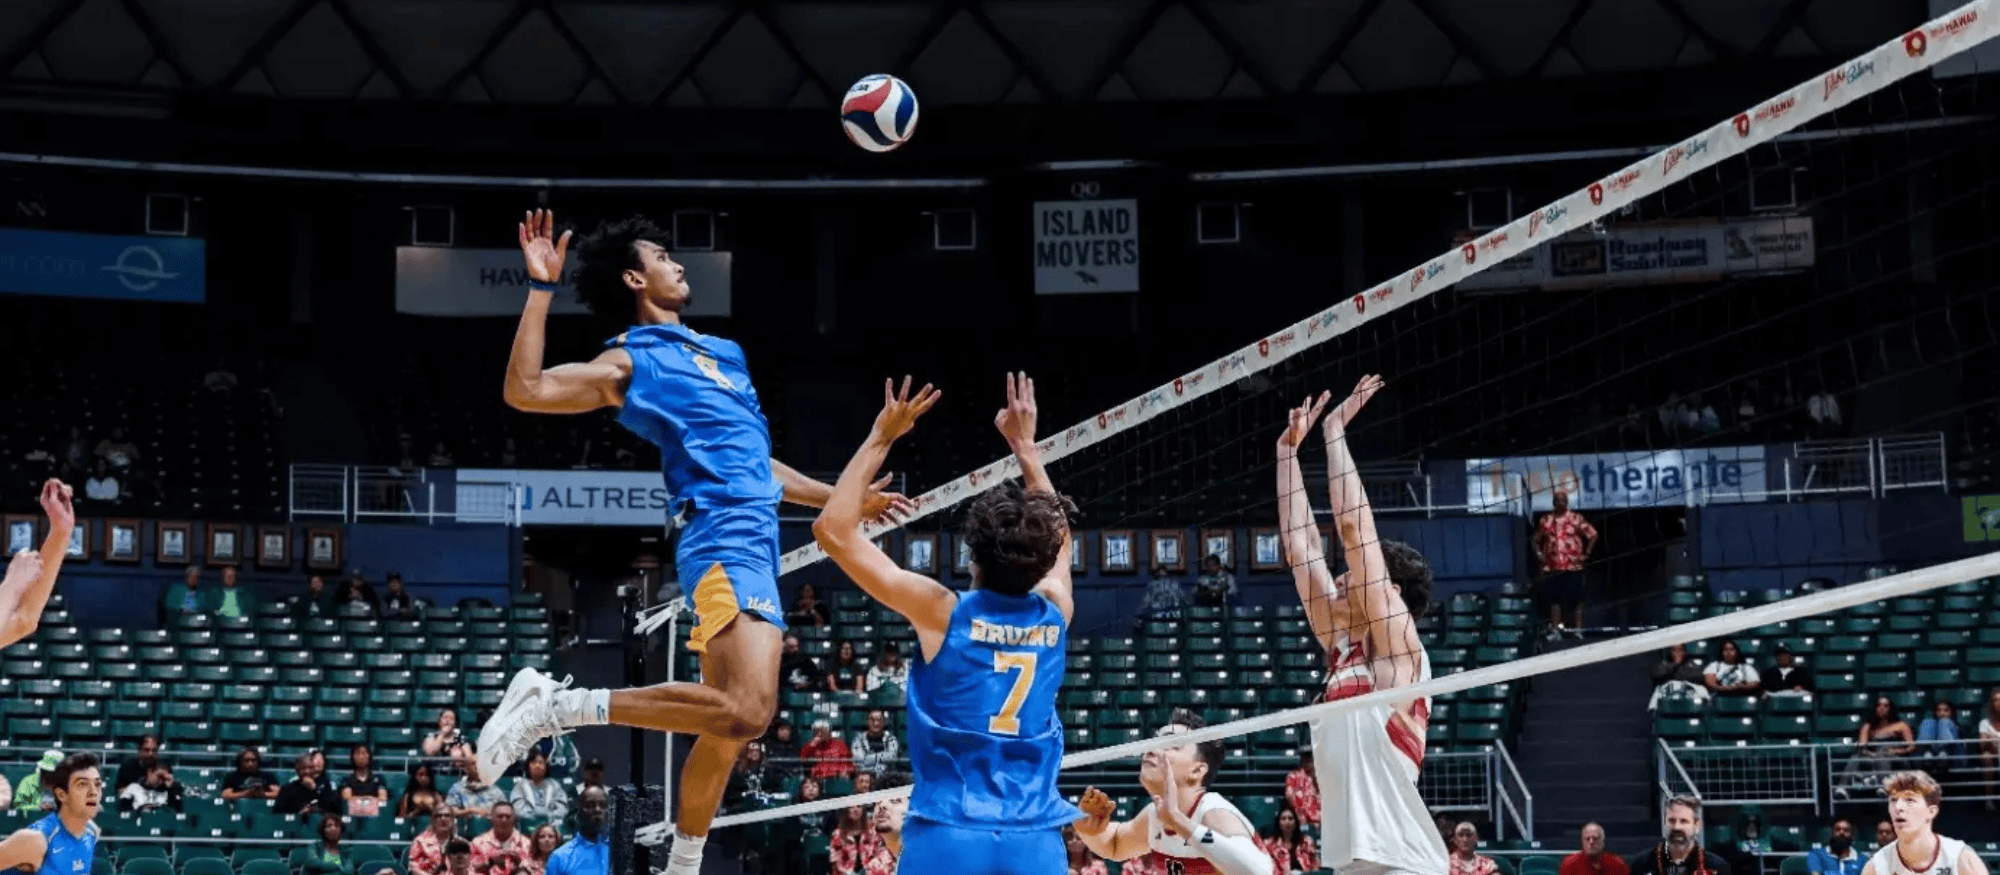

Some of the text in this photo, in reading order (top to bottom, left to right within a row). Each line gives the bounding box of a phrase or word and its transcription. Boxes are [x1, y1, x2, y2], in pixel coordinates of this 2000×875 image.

[1043, 208, 1130, 236] ISLAND
[1037, 239, 1137, 267] MOVERS
[970, 619, 1059, 648] BRUINS
[988, 650, 1037, 736] 7
